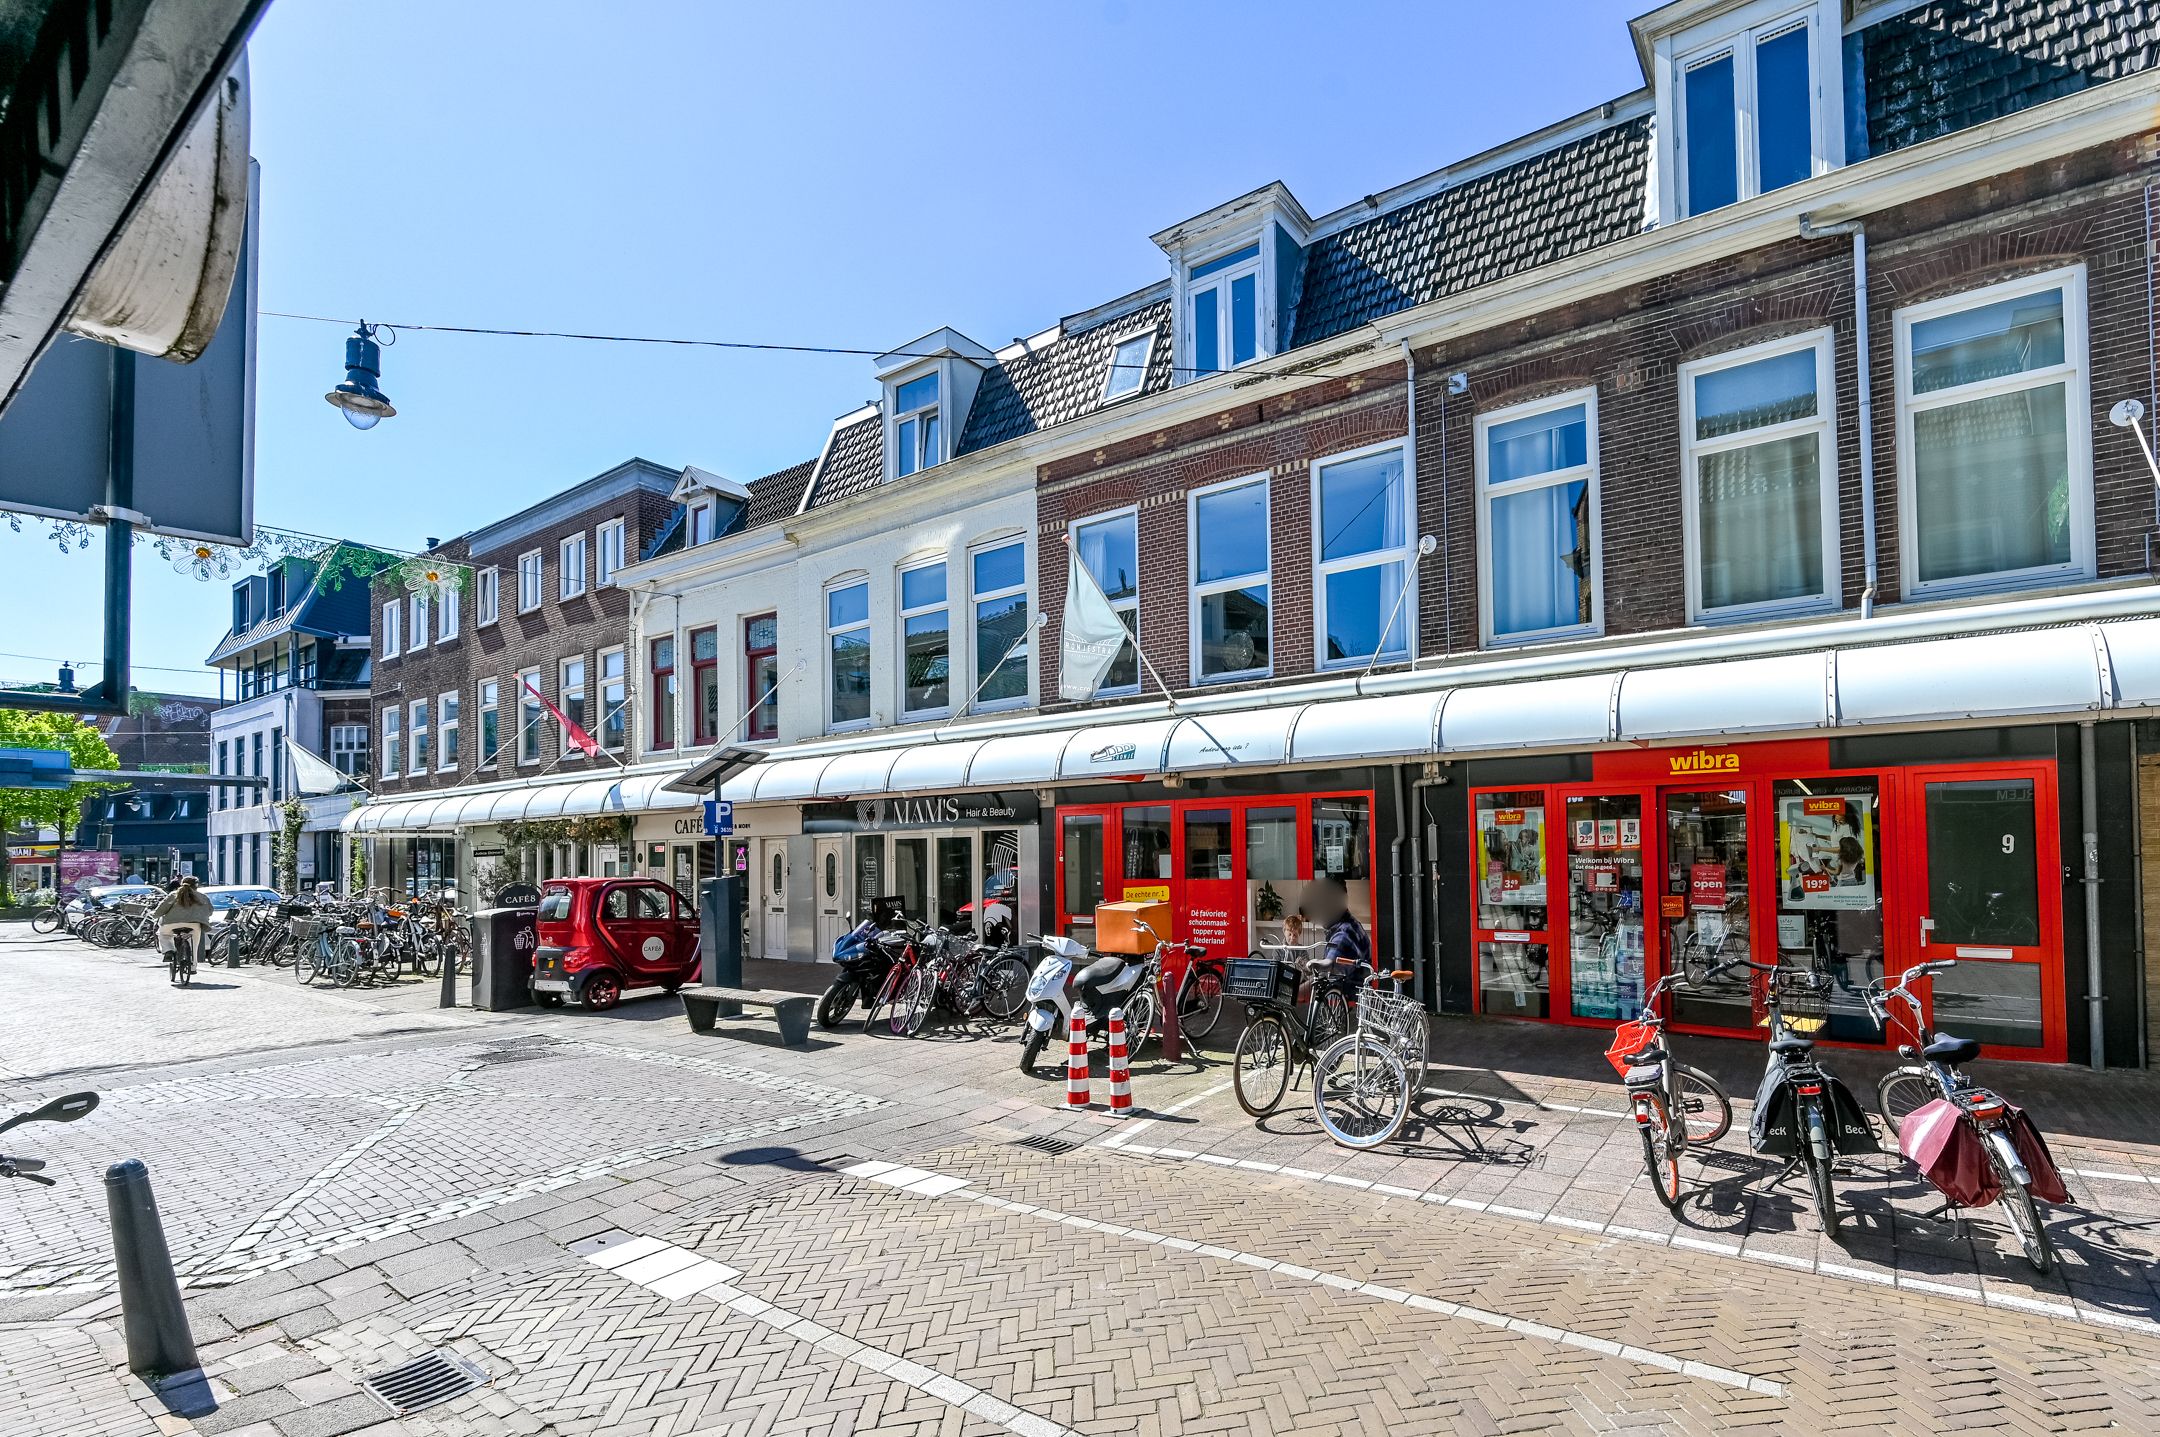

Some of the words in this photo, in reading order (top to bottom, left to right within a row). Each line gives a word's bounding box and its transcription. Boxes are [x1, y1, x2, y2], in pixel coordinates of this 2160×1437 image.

[1669, 750, 1739, 771] wibra
[893, 797, 959, 824] MAM'S
[966, 808, 980, 817] Hair
[982, 808, 988, 816] &
[990, 807, 1016, 818] Beauty
[1808, 800, 1840, 810] wibra
[716, 802, 731, 824] P
[1498, 812, 1521, 820] wibra
[674, 816, 703, 834] CAFÉ
[2002, 834, 2014, 854] 9
[1694, 881, 1722, 890] open
[505, 894, 536, 904] CAFÉ8
[1193, 928, 1213, 936] topper
